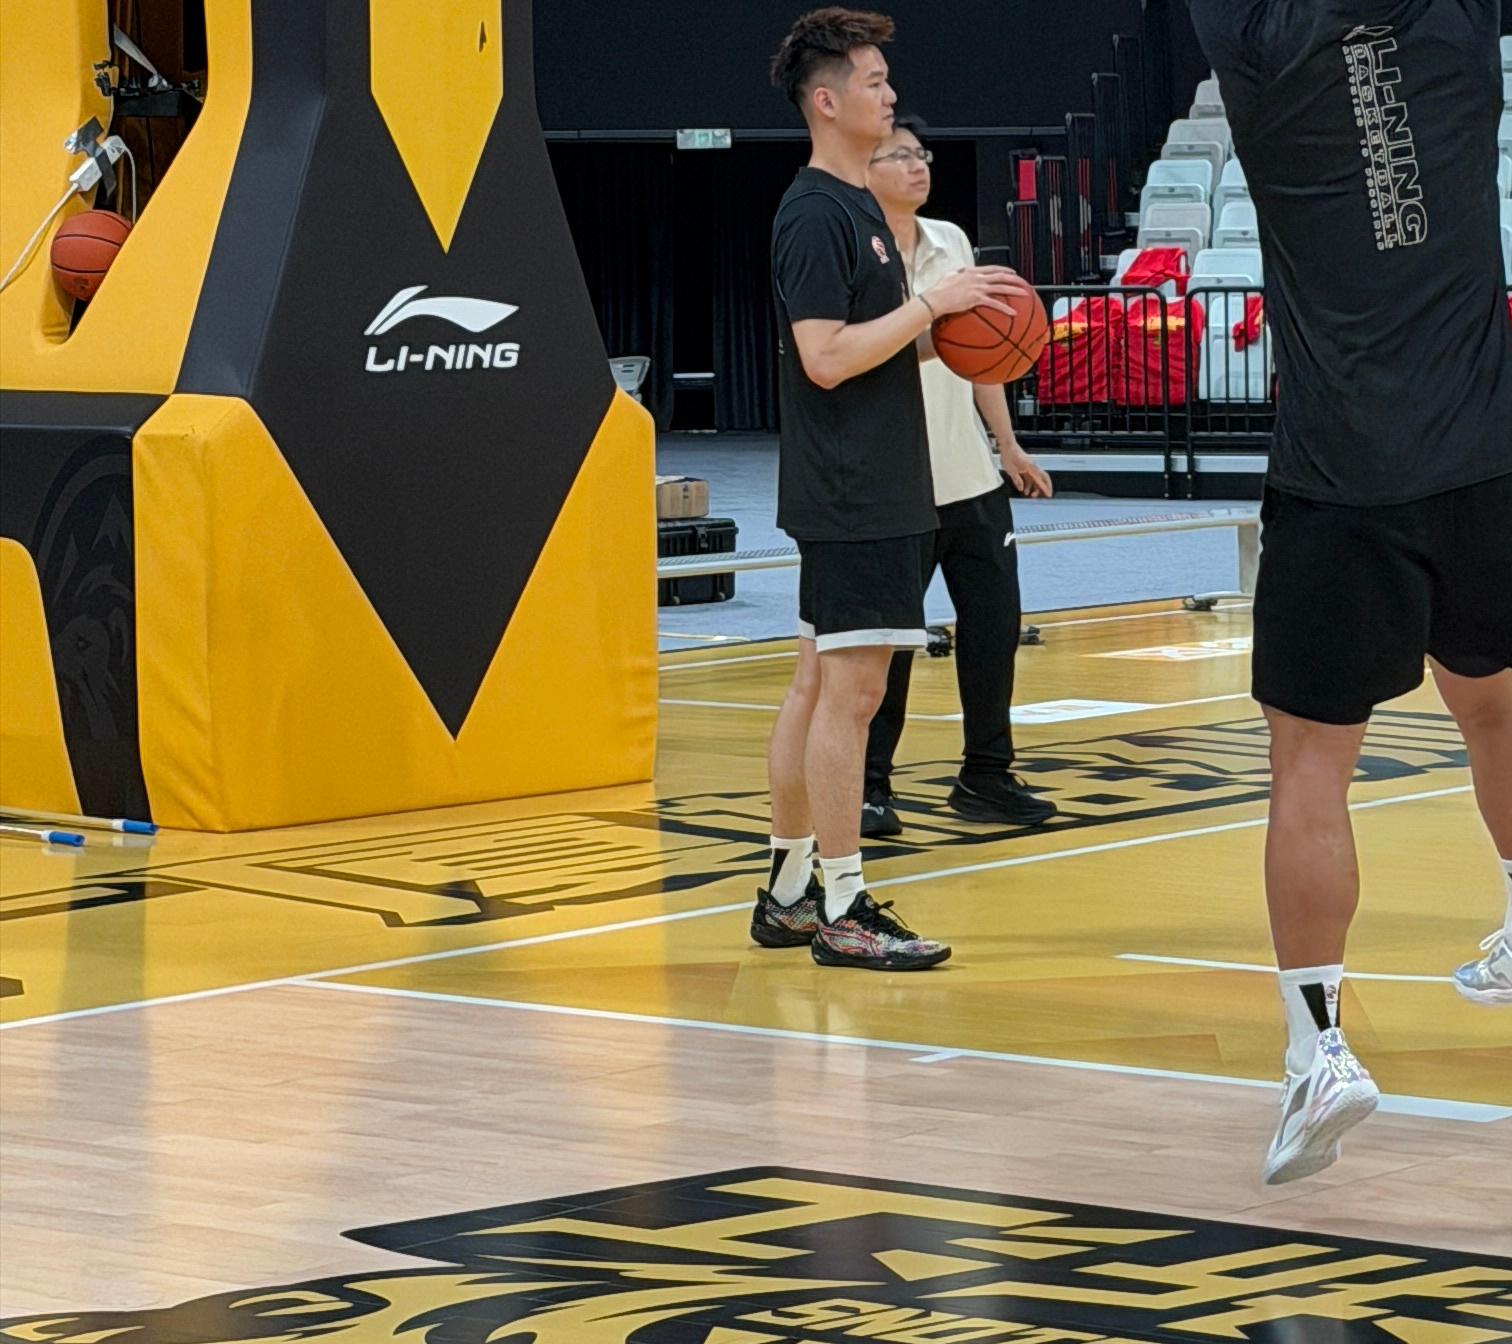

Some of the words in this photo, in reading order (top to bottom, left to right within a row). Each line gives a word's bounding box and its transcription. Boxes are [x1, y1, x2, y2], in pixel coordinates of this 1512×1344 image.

[1352, 44, 1398, 250] BASKETBALL
[1368, 36, 1428, 246] LI-NING
[365, 342, 520, 372] LI-NING
